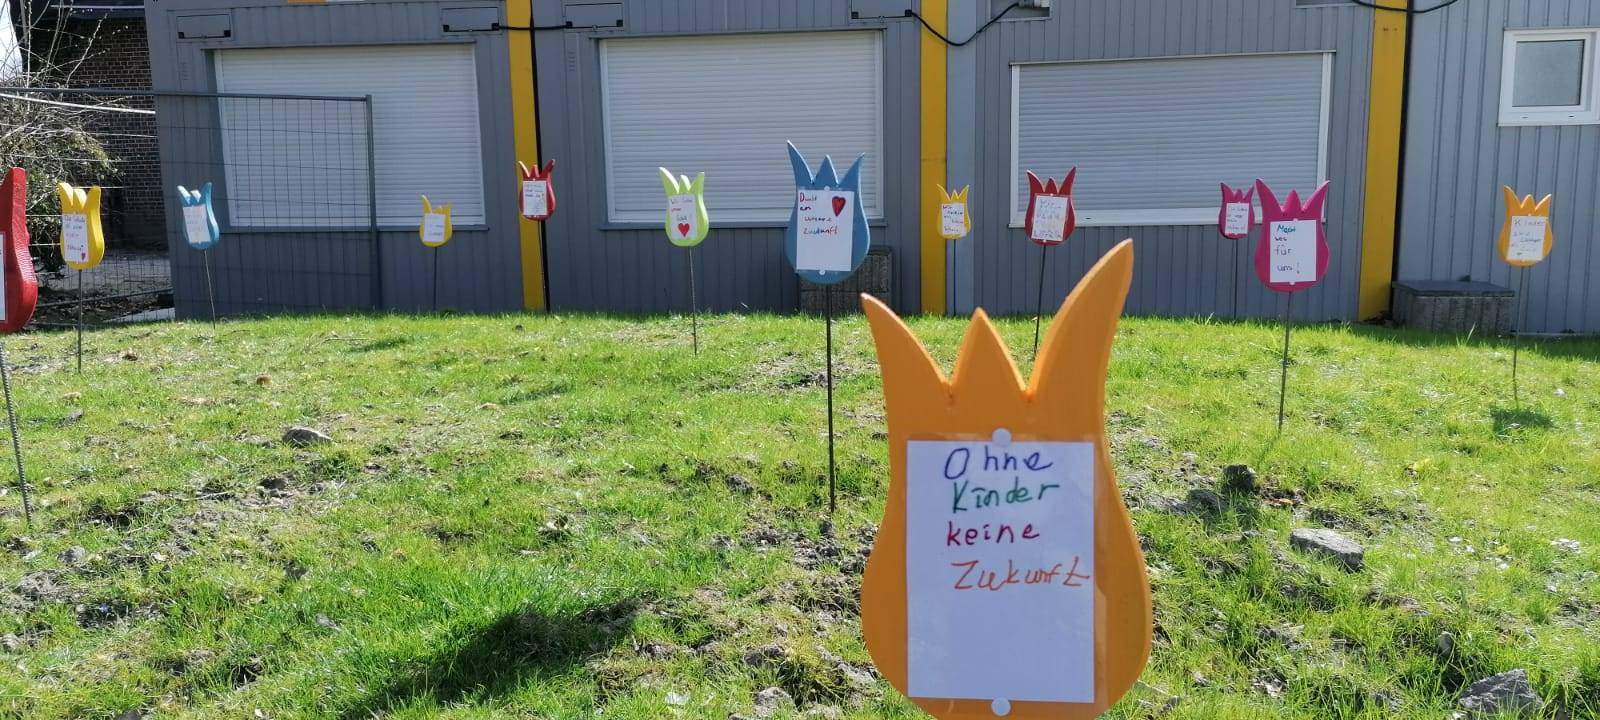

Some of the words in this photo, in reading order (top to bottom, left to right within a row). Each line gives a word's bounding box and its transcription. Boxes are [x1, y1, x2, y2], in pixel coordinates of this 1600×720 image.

[944, 445, 1053, 479] Ohne
[952, 476, 1061, 514] Kinder
[946, 521, 1040, 547] keine
